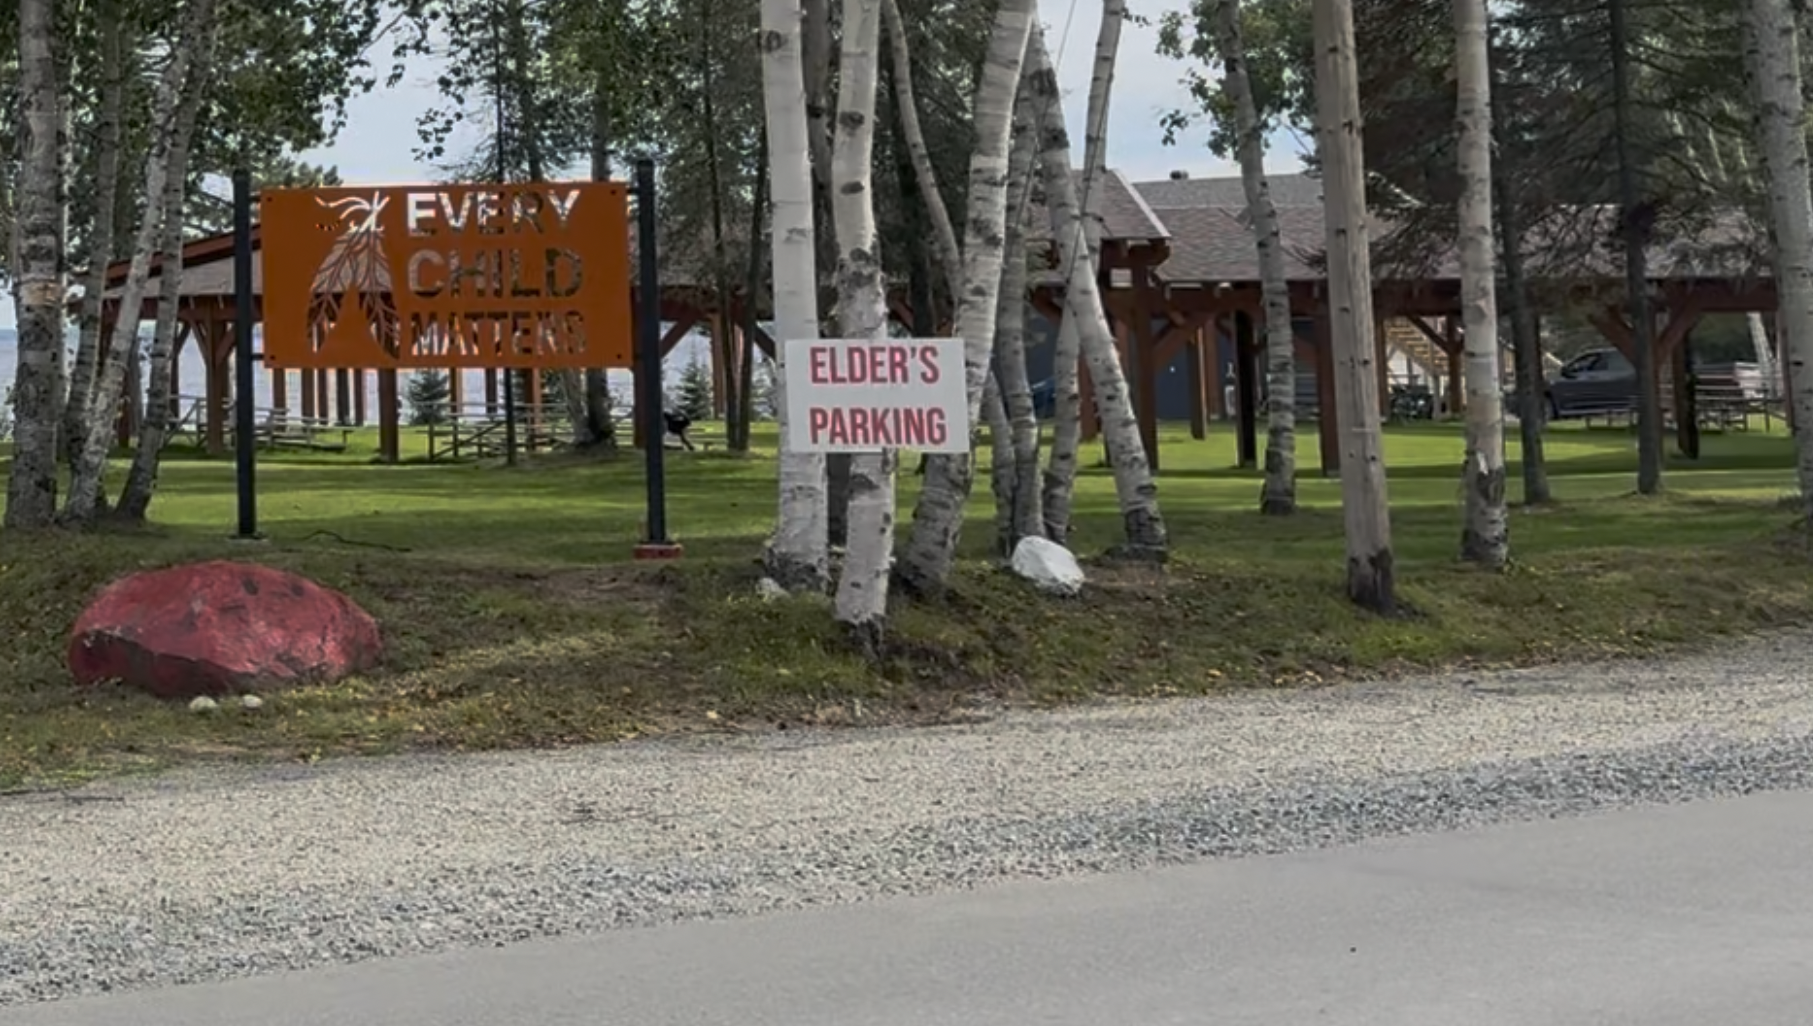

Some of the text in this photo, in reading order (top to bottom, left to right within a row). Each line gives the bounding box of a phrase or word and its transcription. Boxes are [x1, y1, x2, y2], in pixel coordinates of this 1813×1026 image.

[406, 189, 581, 236] EVERY
[407, 248, 584, 299] CHILD
[410, 310, 586, 356] MATTERS
[809, 345, 940, 384] ELDER'S
[809, 407, 947, 445] PARKING
